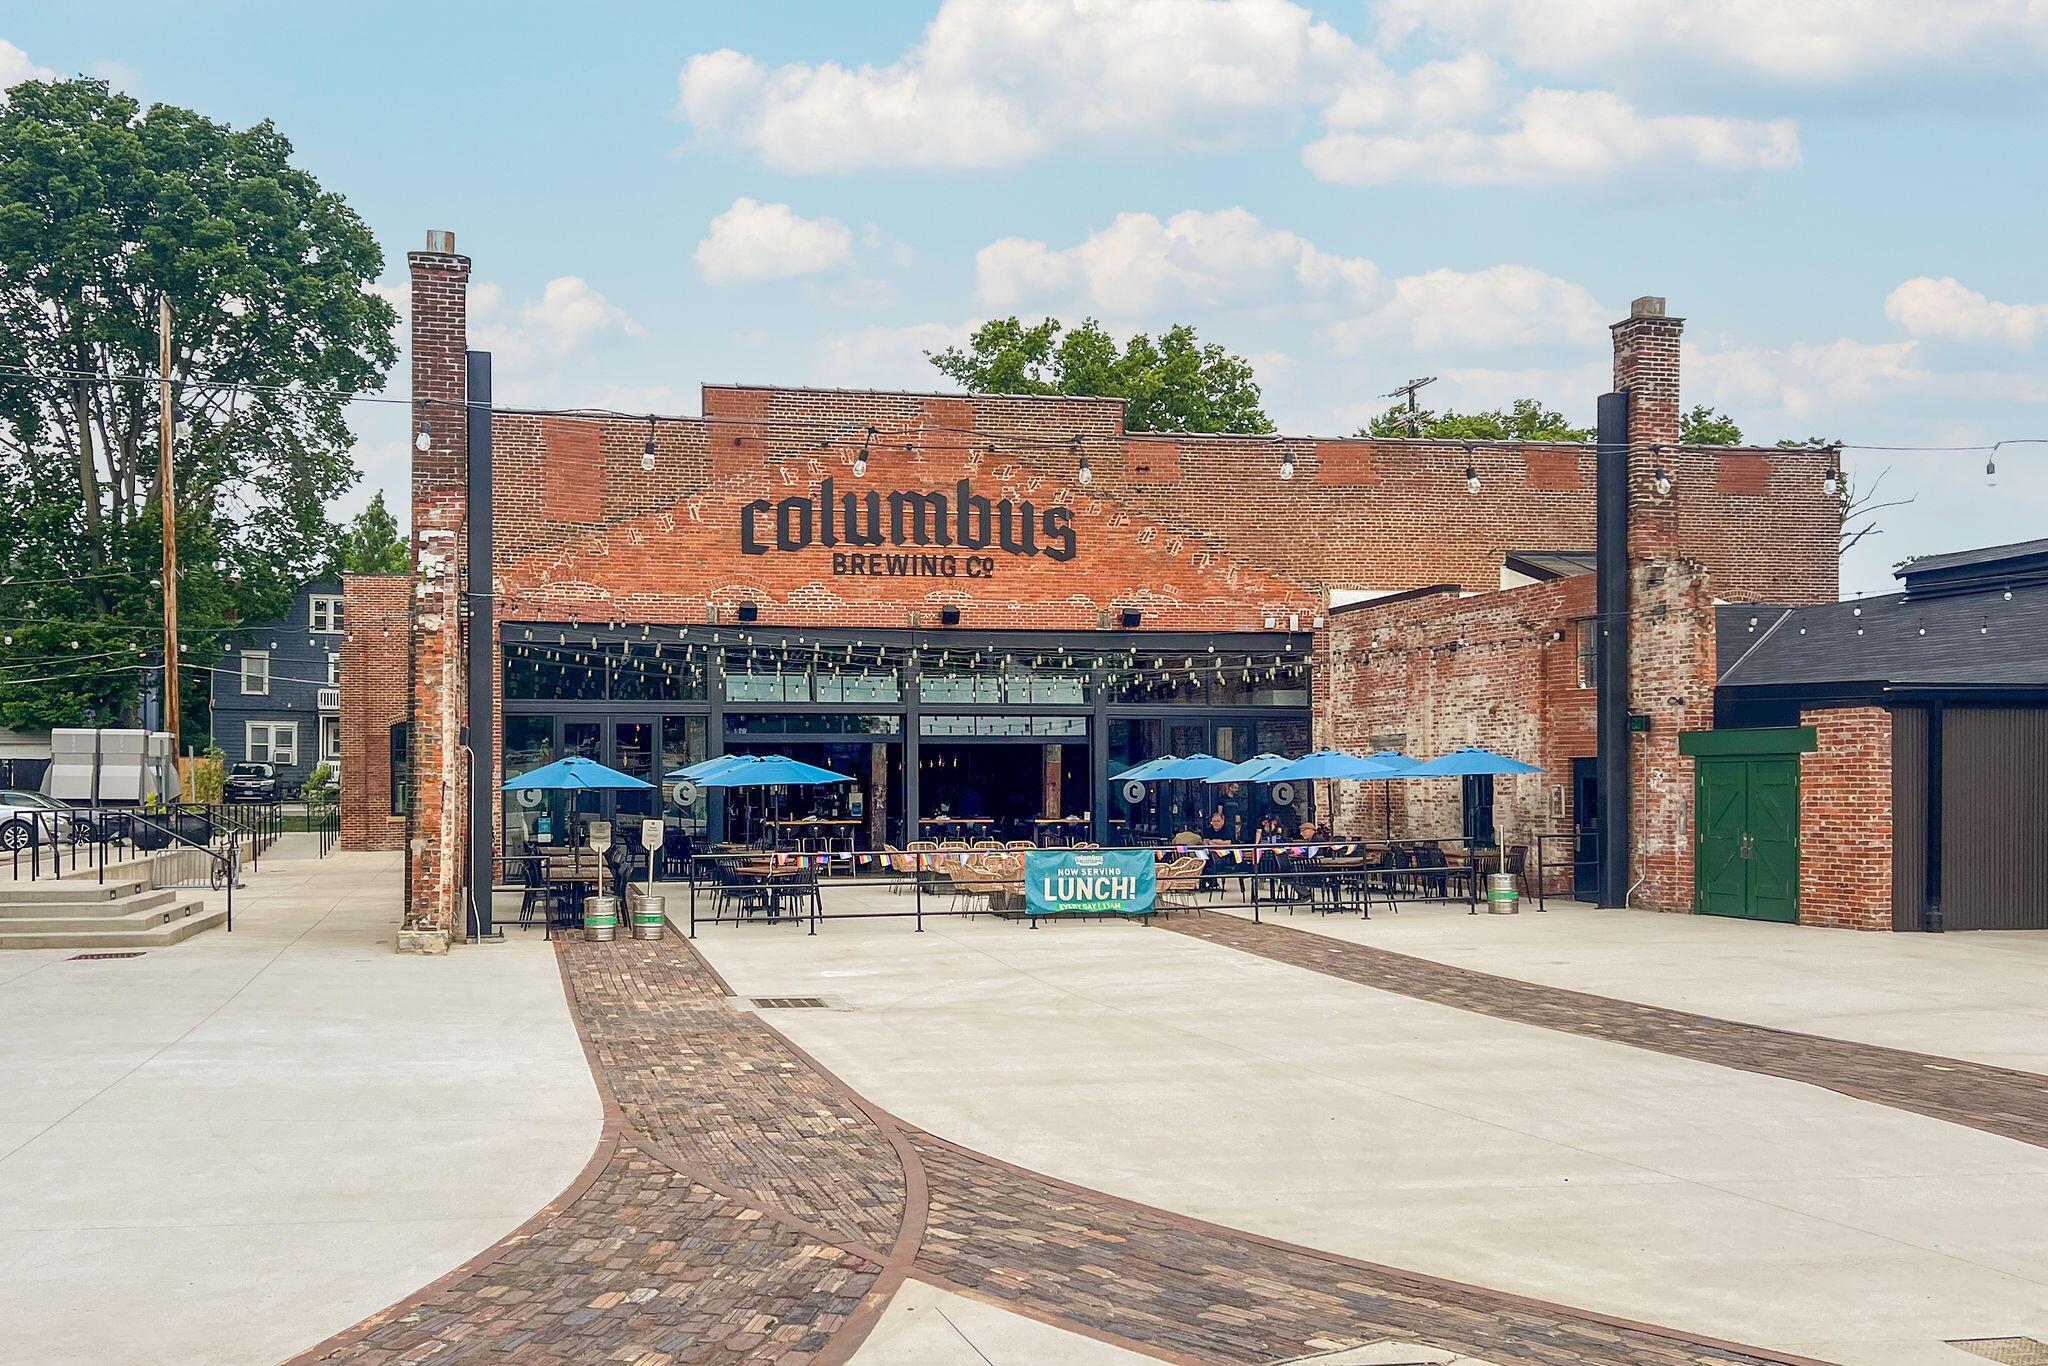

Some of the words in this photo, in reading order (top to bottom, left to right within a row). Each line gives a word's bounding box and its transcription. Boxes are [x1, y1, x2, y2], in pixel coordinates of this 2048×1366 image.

[832, 552, 956, 578] BREWING
[1058, 868, 1079, 876] NOW
[1082, 868, 1121, 876] SERVING
[1044, 876, 1136, 901] LUNCH!
